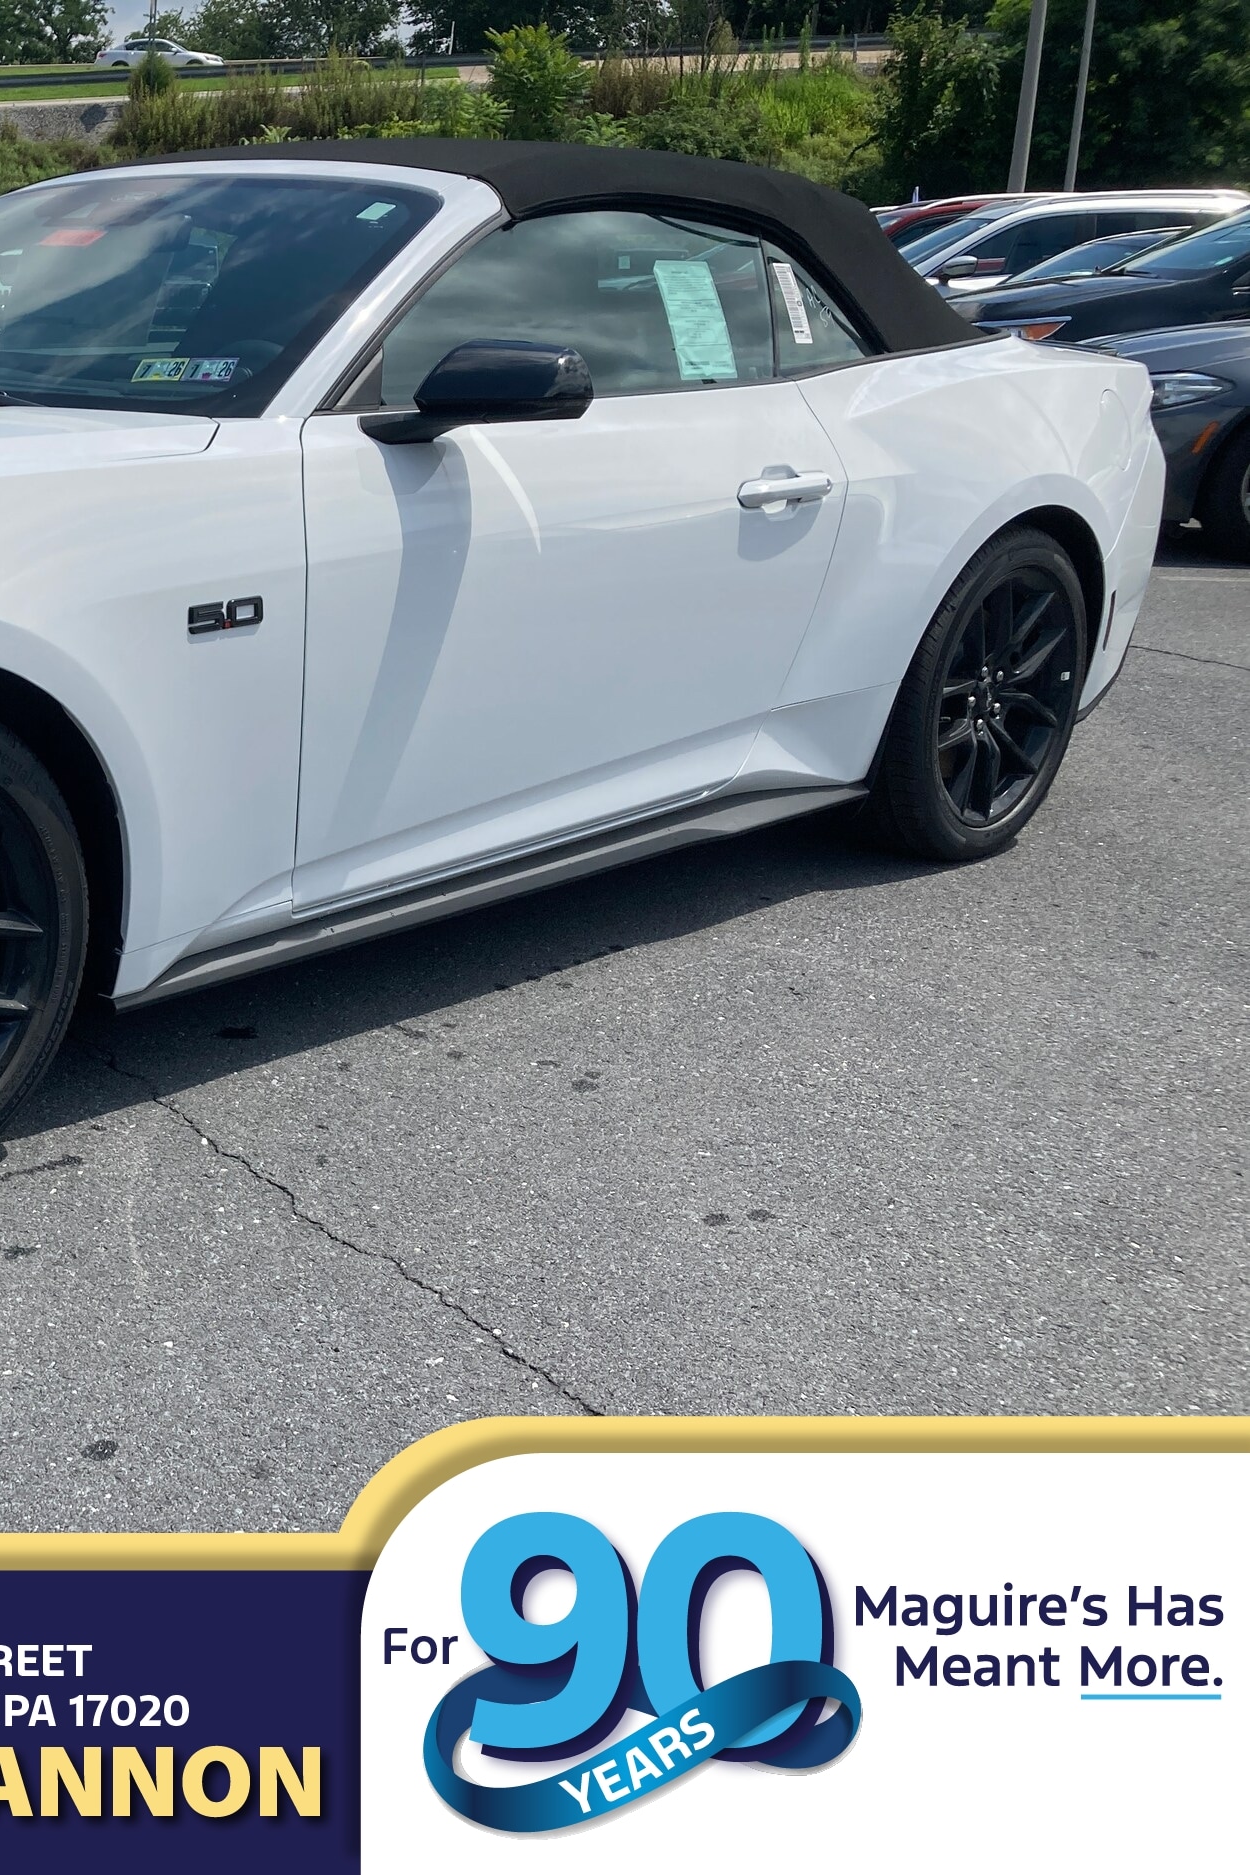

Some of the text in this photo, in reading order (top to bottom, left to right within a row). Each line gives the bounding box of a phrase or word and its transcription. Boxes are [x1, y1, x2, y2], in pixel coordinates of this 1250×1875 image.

[167, 361, 185, 377] 26
[217, 361, 235, 378] 26
[188, 595, 264, 634] 5.0
